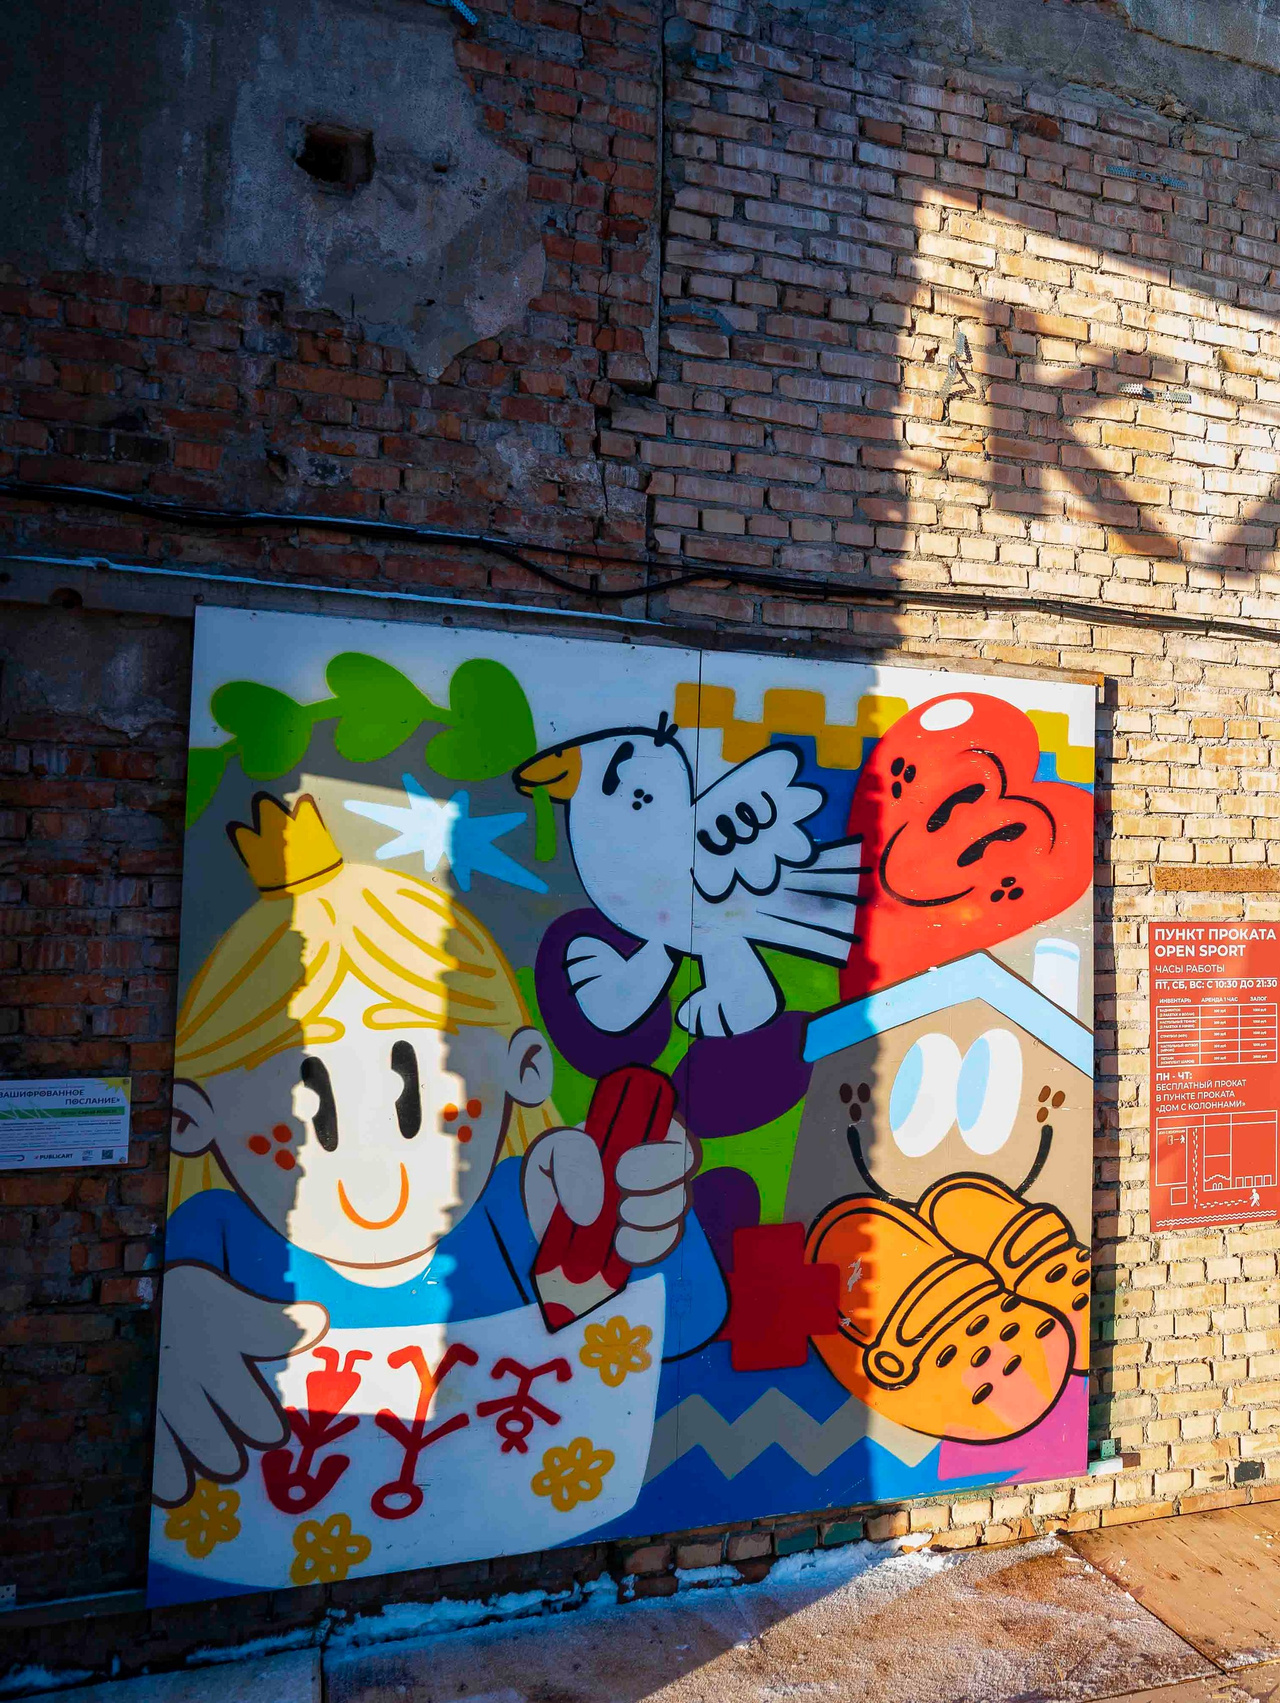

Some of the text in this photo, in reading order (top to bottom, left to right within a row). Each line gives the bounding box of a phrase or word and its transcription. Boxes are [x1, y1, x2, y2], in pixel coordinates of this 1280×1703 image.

[1154, 927, 1277, 941] ПУНКТ ПРОКАТА
[1154, 944, 1247, 957] OPEN SPORT
[1155, 964, 1225, 973] ЧАСЫ РАБОТЫ
[1155, 979, 1278, 990] ПТ, СБ, ВС: С 10:30 ДО 21:30
[1156, 1072, 1170, 1081] ПН
[1178, 1071, 1193, 1080] ЧТ:
[1156, 1079, 1247, 1092] БЕСПЛАТНЫЙ ПРОКАТ
[1156, 1090, 1236, 1102] В ПУНКТЕ ПРОКАТА
[1156, 1104, 1179, 1114] «ДОМ
[1188, 1100, 1246, 1111] КОЛОННАМИ»
